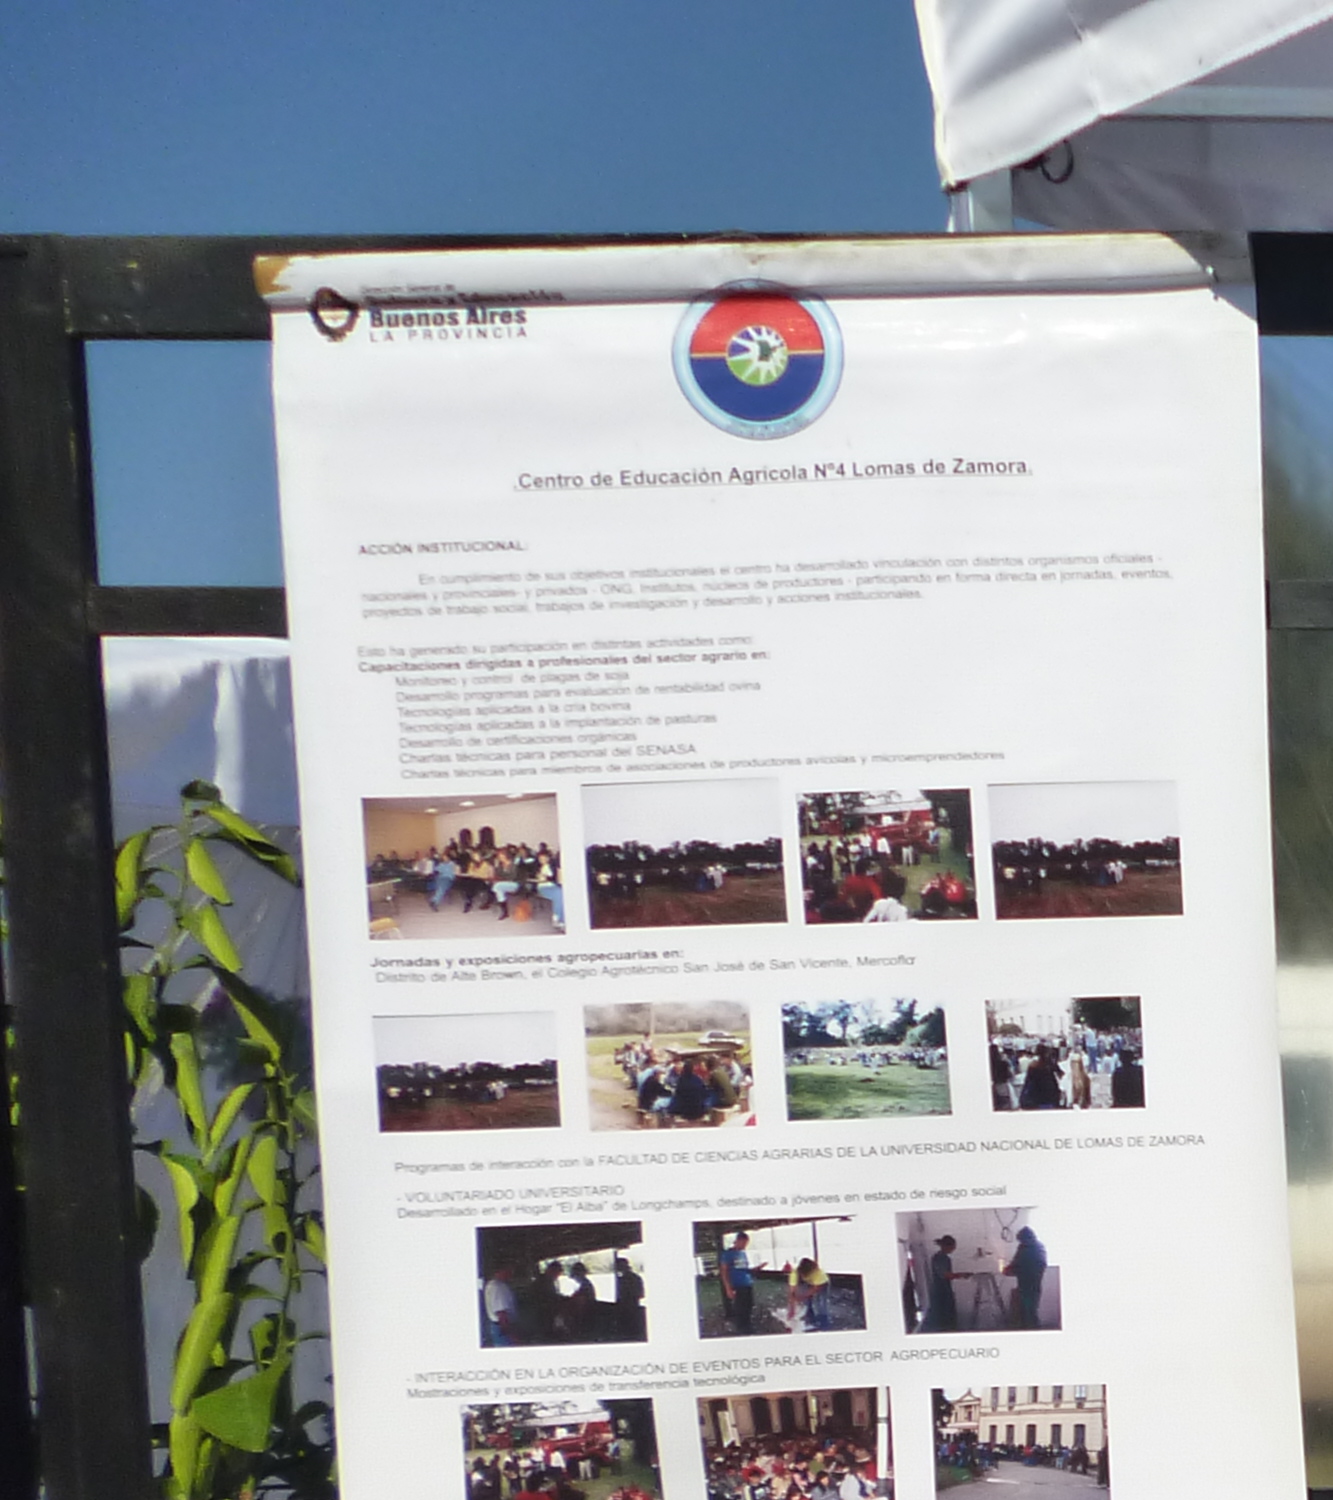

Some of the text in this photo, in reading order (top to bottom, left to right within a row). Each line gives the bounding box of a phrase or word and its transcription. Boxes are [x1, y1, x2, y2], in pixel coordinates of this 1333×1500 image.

[369, 305, 527, 328] Buenos Aires
[369, 327, 527, 343] LA PROVINCIA
[589, 470, 612, 487] de
[619, 467, 722, 486] Educación
[851, 461, 915, 479] Lomas
[922, 460, 945, 477] de
[357, 541, 412, 556] ACCIÓN
[357, 650, 770, 676] Capacitaciones dirigidas a profesionales del sector agrario en:
[369, 947, 683, 969] Jornadas y exposiciones agropecuarias en:
[393, 1133, 1205, 1176] Programas de interacción con la FACULTAD DE CIENCIAS AGRARIAS DE LA UNIVERSIDAD NACIONAL DE LOMAS DE ZAMORA
[404, 1184, 625, 1203] VOLUNTARIADO UNIVERSITARIO
[414, 1348, 1000, 1384] INTERACCIÓN EN LA ORGANIZACIÓN DE EVENTOS PARA EL SECTOR AGROPECUARIO
